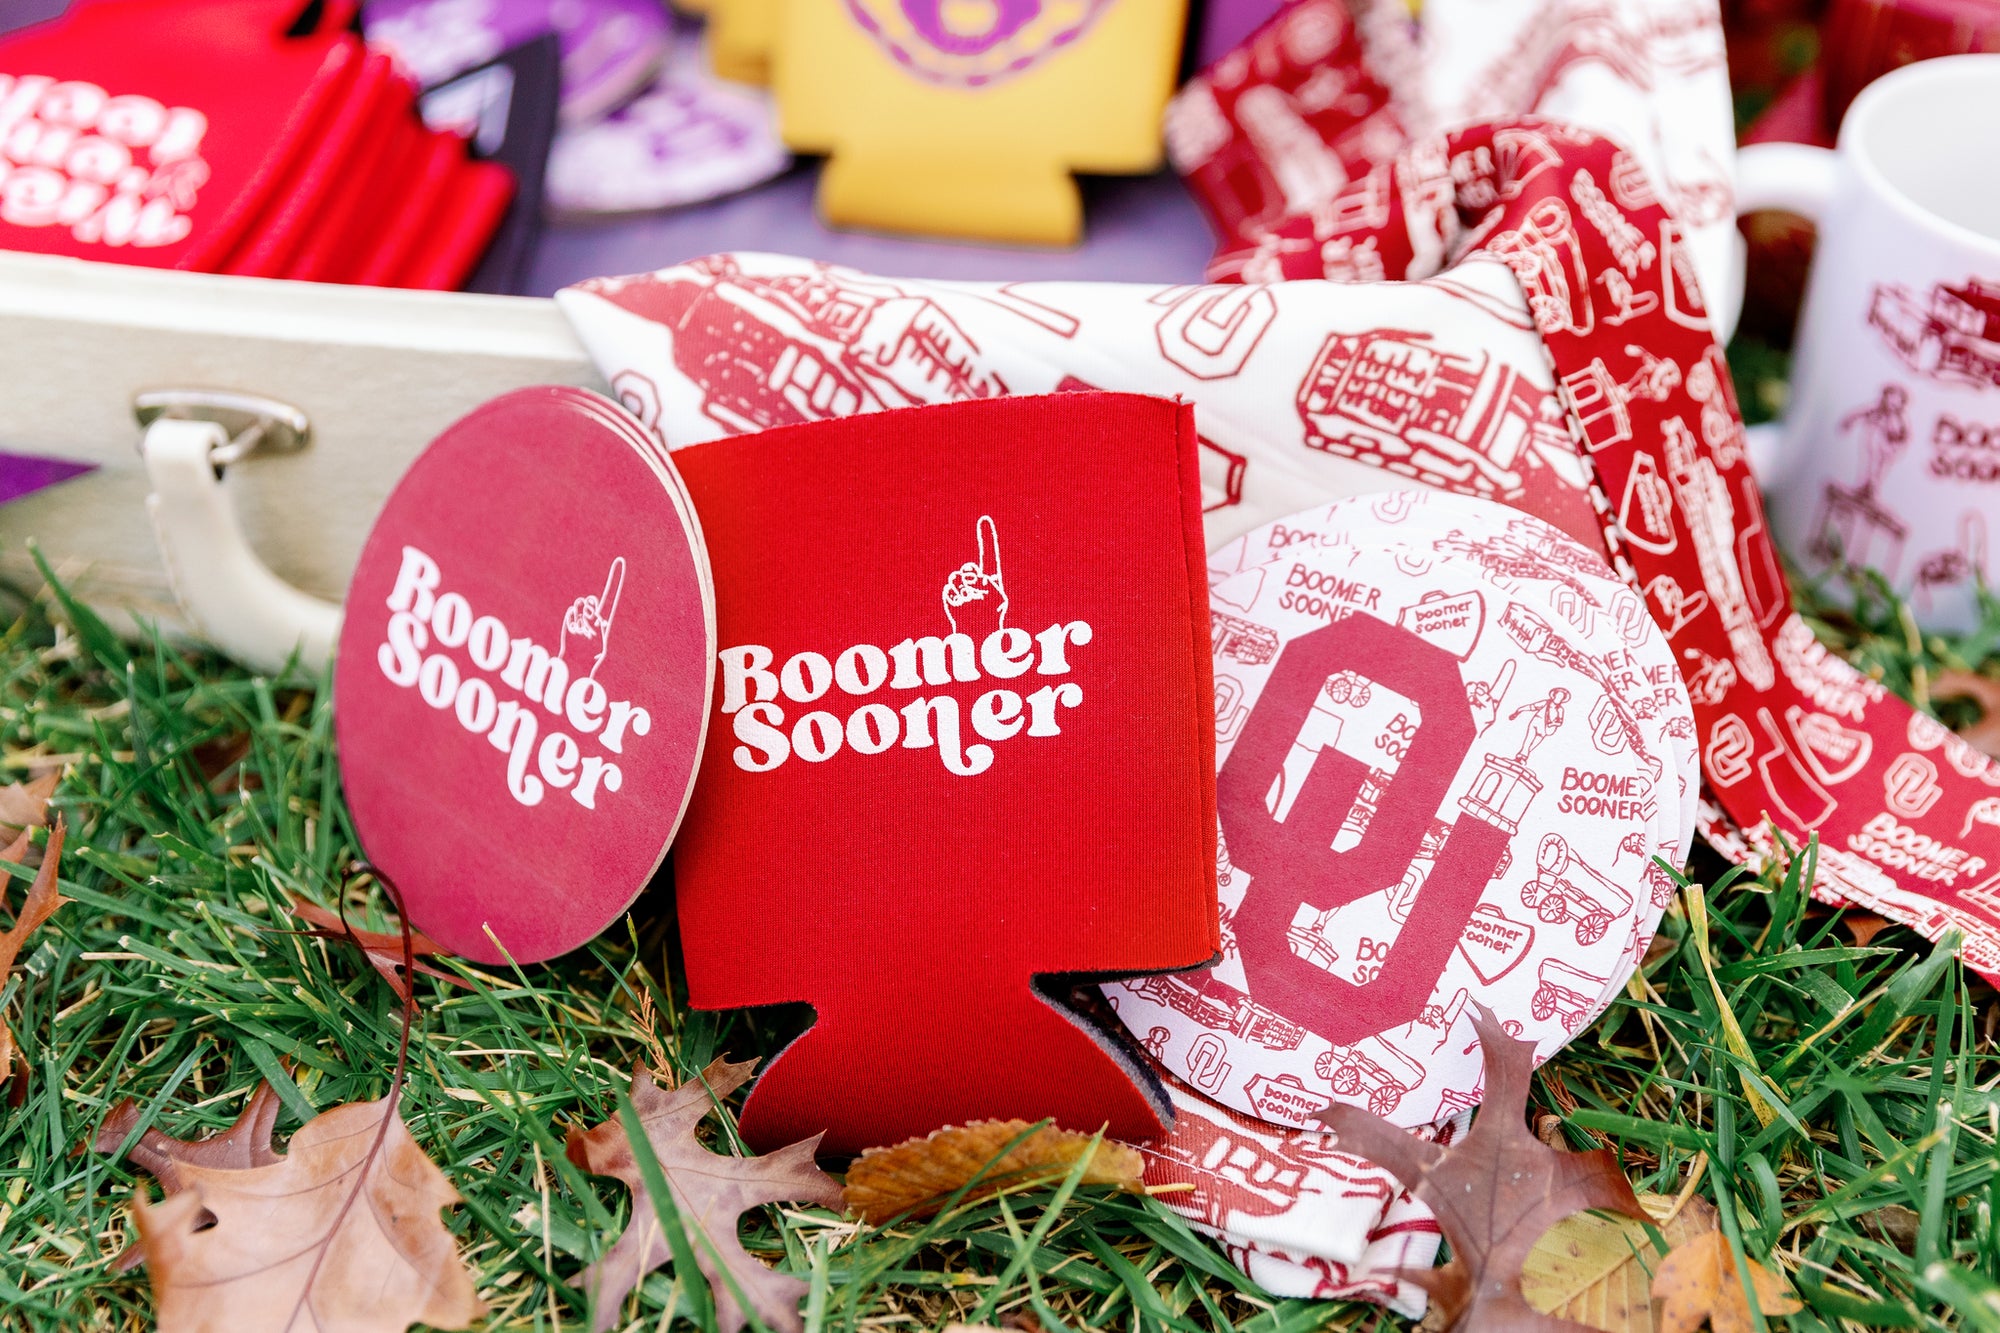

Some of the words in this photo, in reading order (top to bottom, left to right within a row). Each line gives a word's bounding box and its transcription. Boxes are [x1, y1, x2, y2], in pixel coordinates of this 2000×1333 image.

[1279, 591, 1352, 623] SOONE
[1286, 563, 1381, 610] BOOMER
[1415, 600, 1473, 622] boomer
[1415, 616, 1470, 634] sooner
[386, 545, 651, 754] Boomer
[718, 620, 1092, 714] Boomer
[377, 610, 622, 810] Sooner
[732, 683, 1083, 776] Sooner
[1561, 767, 1640, 798] BOOME
[1558, 794, 1646, 821] SOONER
[1847, 834, 1958, 886] SOONER
[1862, 812, 1987, 878] BOOMER
[1264, 1083, 1323, 1112] boomer
